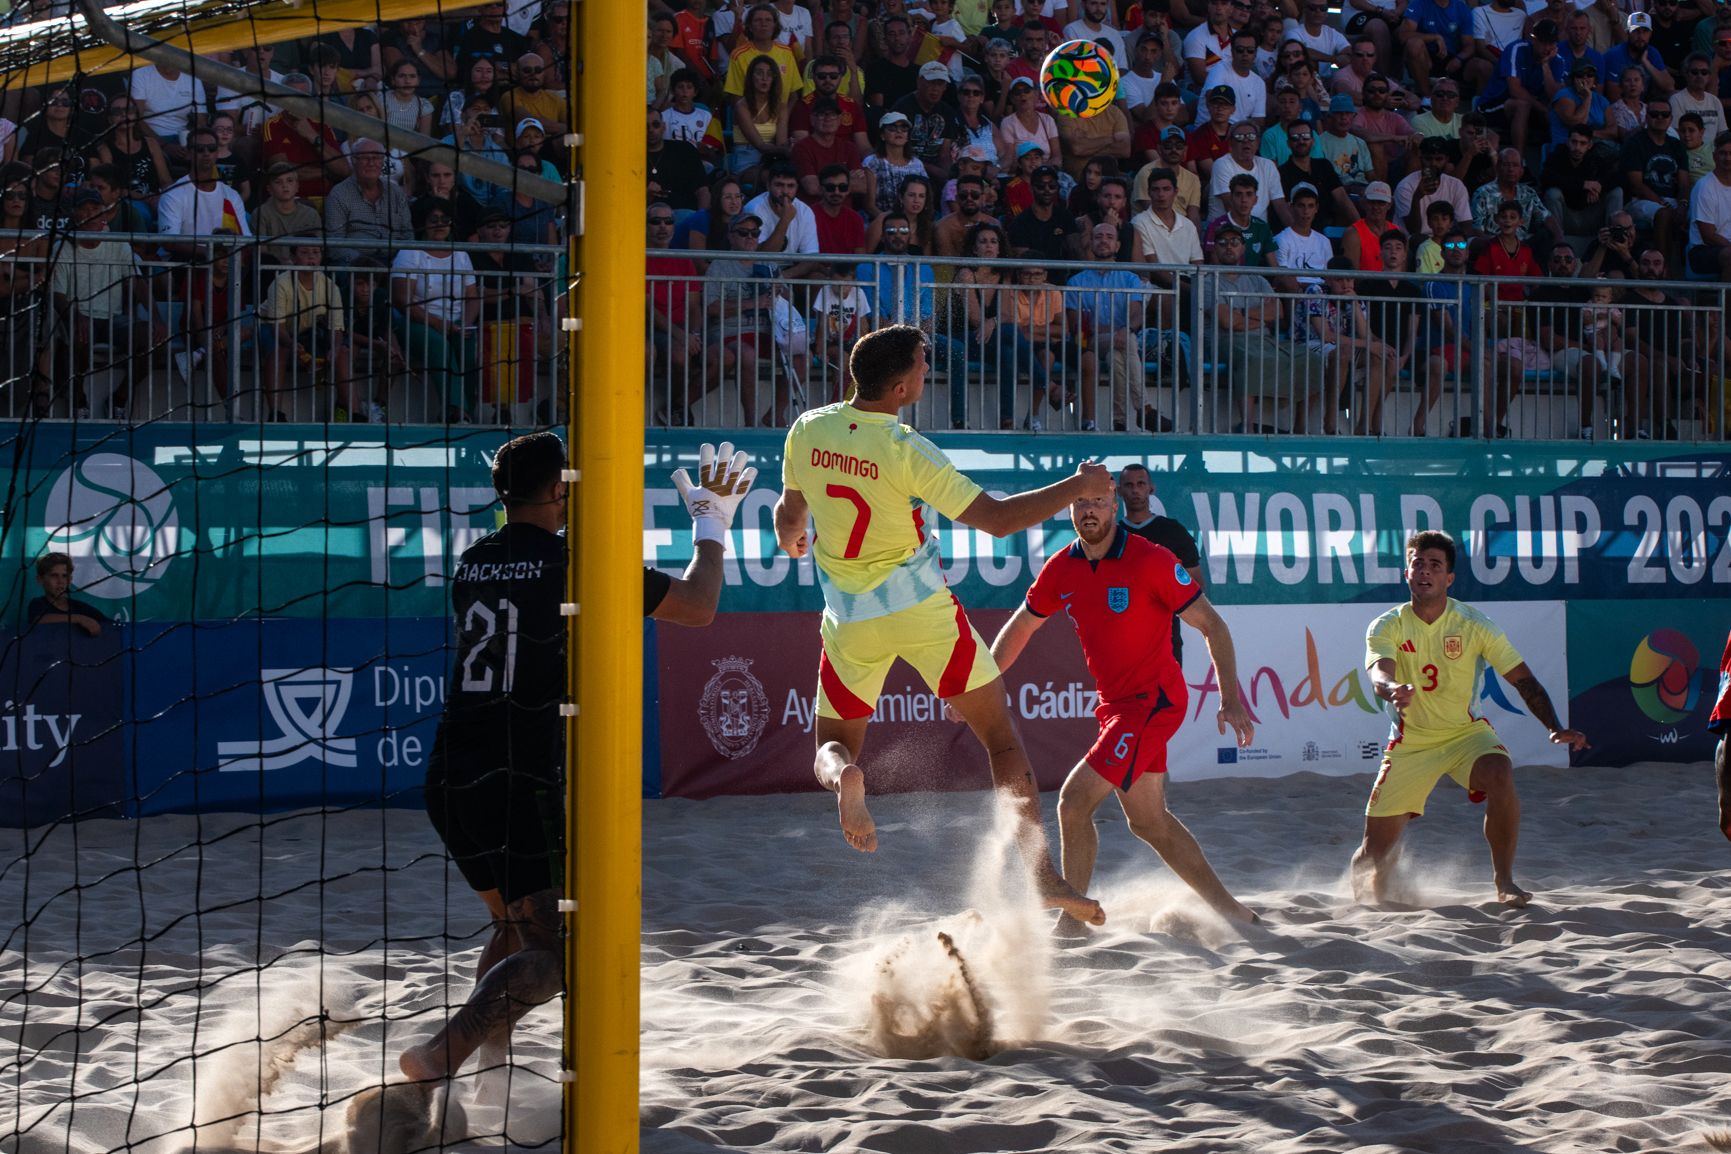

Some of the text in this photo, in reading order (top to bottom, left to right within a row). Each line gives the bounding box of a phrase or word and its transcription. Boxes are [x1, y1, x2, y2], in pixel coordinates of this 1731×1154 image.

[811, 448, 879, 480] DOMINGO
[367, 487, 494, 587] FIF
[1469, 494, 1602, 585] CUP
[826, 484, 872, 558] 7
[459, 560, 543, 581] JACKSON
[462, 598, 519, 692] 21
[1421, 663, 1439, 692] 3
[1019, 681, 1098, 720] Cádiz
[376, 725, 423, 767] de
[1114, 732, 1134, 759] 6
